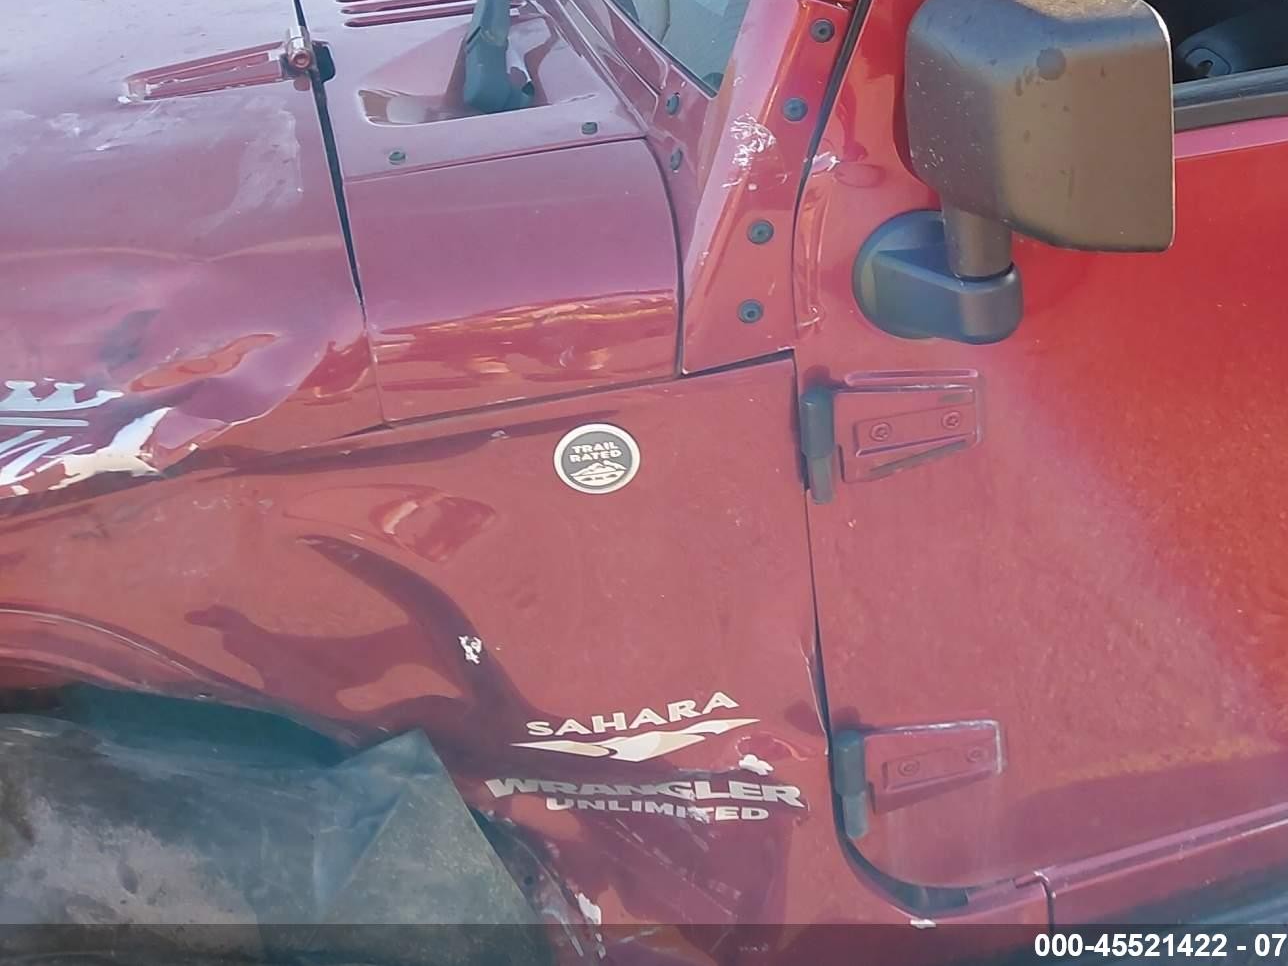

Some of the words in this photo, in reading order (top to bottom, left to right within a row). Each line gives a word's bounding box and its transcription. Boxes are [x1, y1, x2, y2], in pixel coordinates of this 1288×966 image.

[569, 449, 622, 463] RATED
[571, 441, 619, 454] TRAIL
[525, 691, 740, 737] SAHARA
[484, 778, 806, 809] WRANGLER
[545, 797, 770, 823] UNLIMITED
